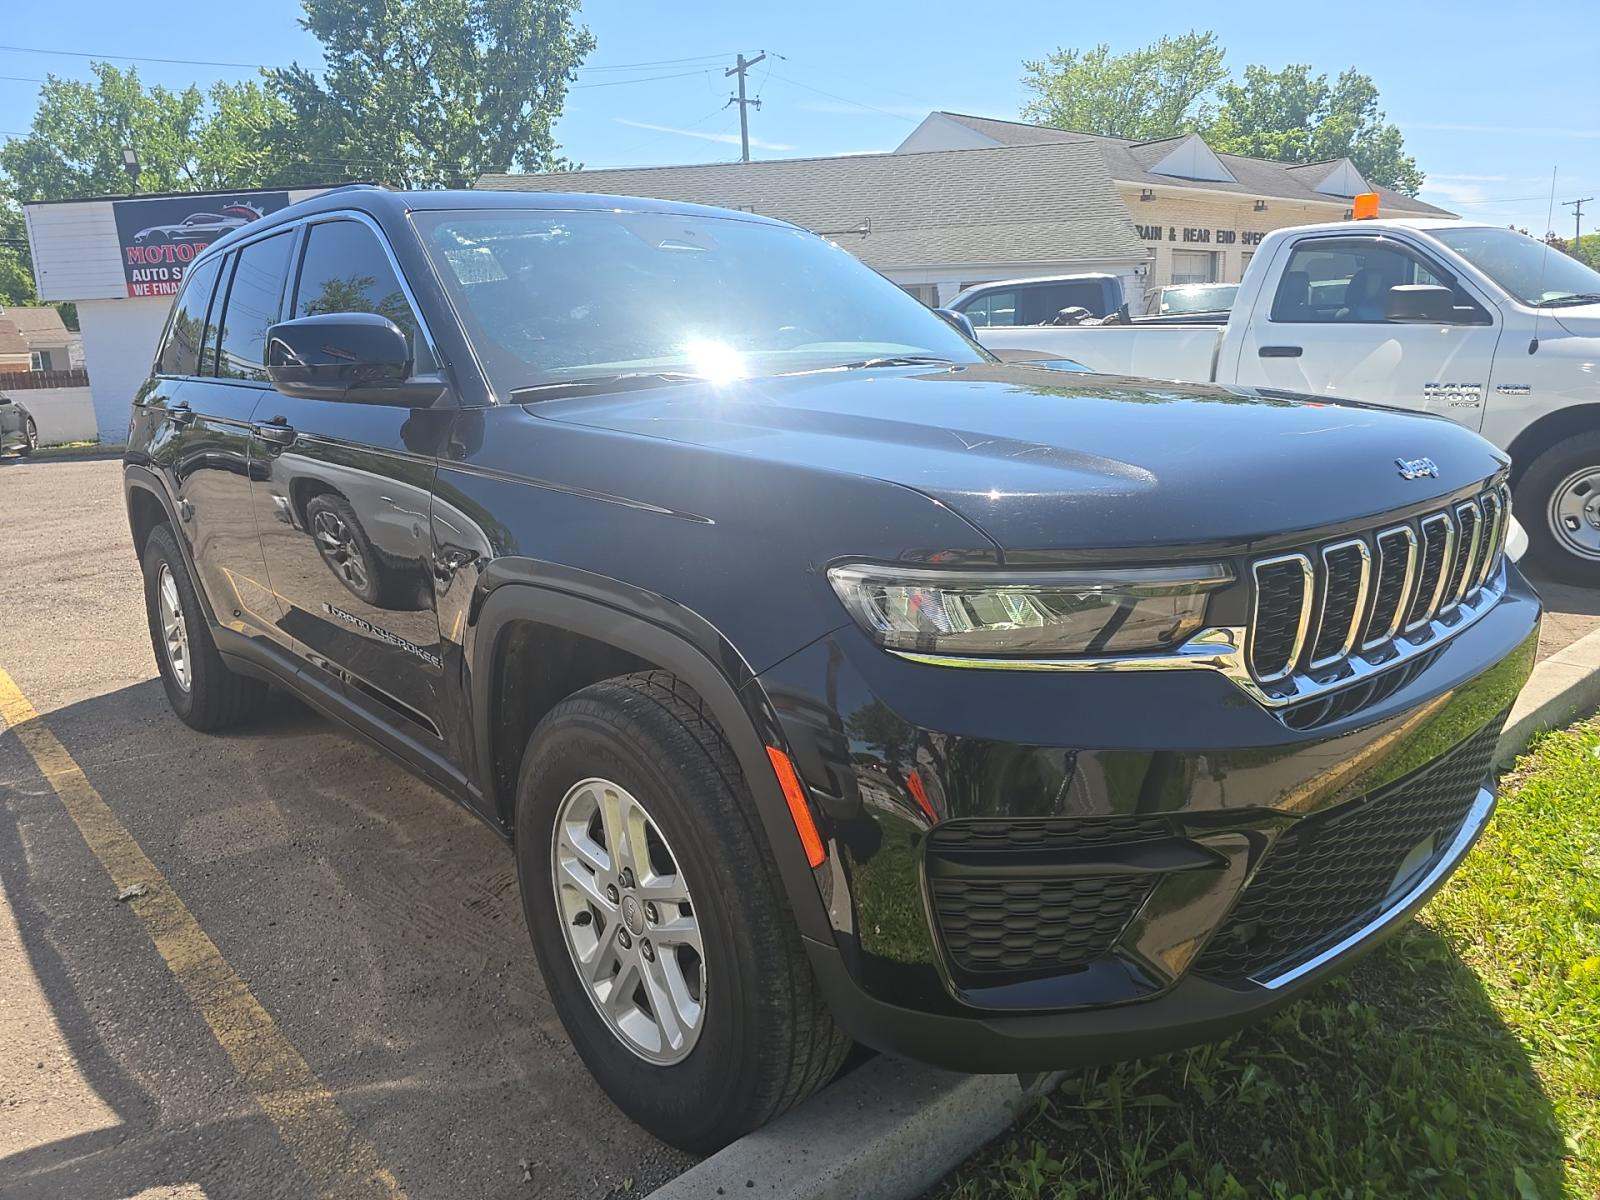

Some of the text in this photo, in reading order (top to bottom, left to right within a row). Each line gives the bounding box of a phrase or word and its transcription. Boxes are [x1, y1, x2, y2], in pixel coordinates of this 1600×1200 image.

[1168, 226, 1177, 242] &
[1183, 228, 1211, 243] REAR
[1216, 229, 1236, 244] END
[1241, 231, 1268, 245] SPEC
[132, 268, 169, 282] AUTO
[133, 281, 181, 296] WE FINA
[1424, 383, 1481, 392] RAM
[1424, 392, 1480, 402] 1500
[1394, 457, 1439, 480] Jeep
[372, 626, 443, 669] CHEROKEE
